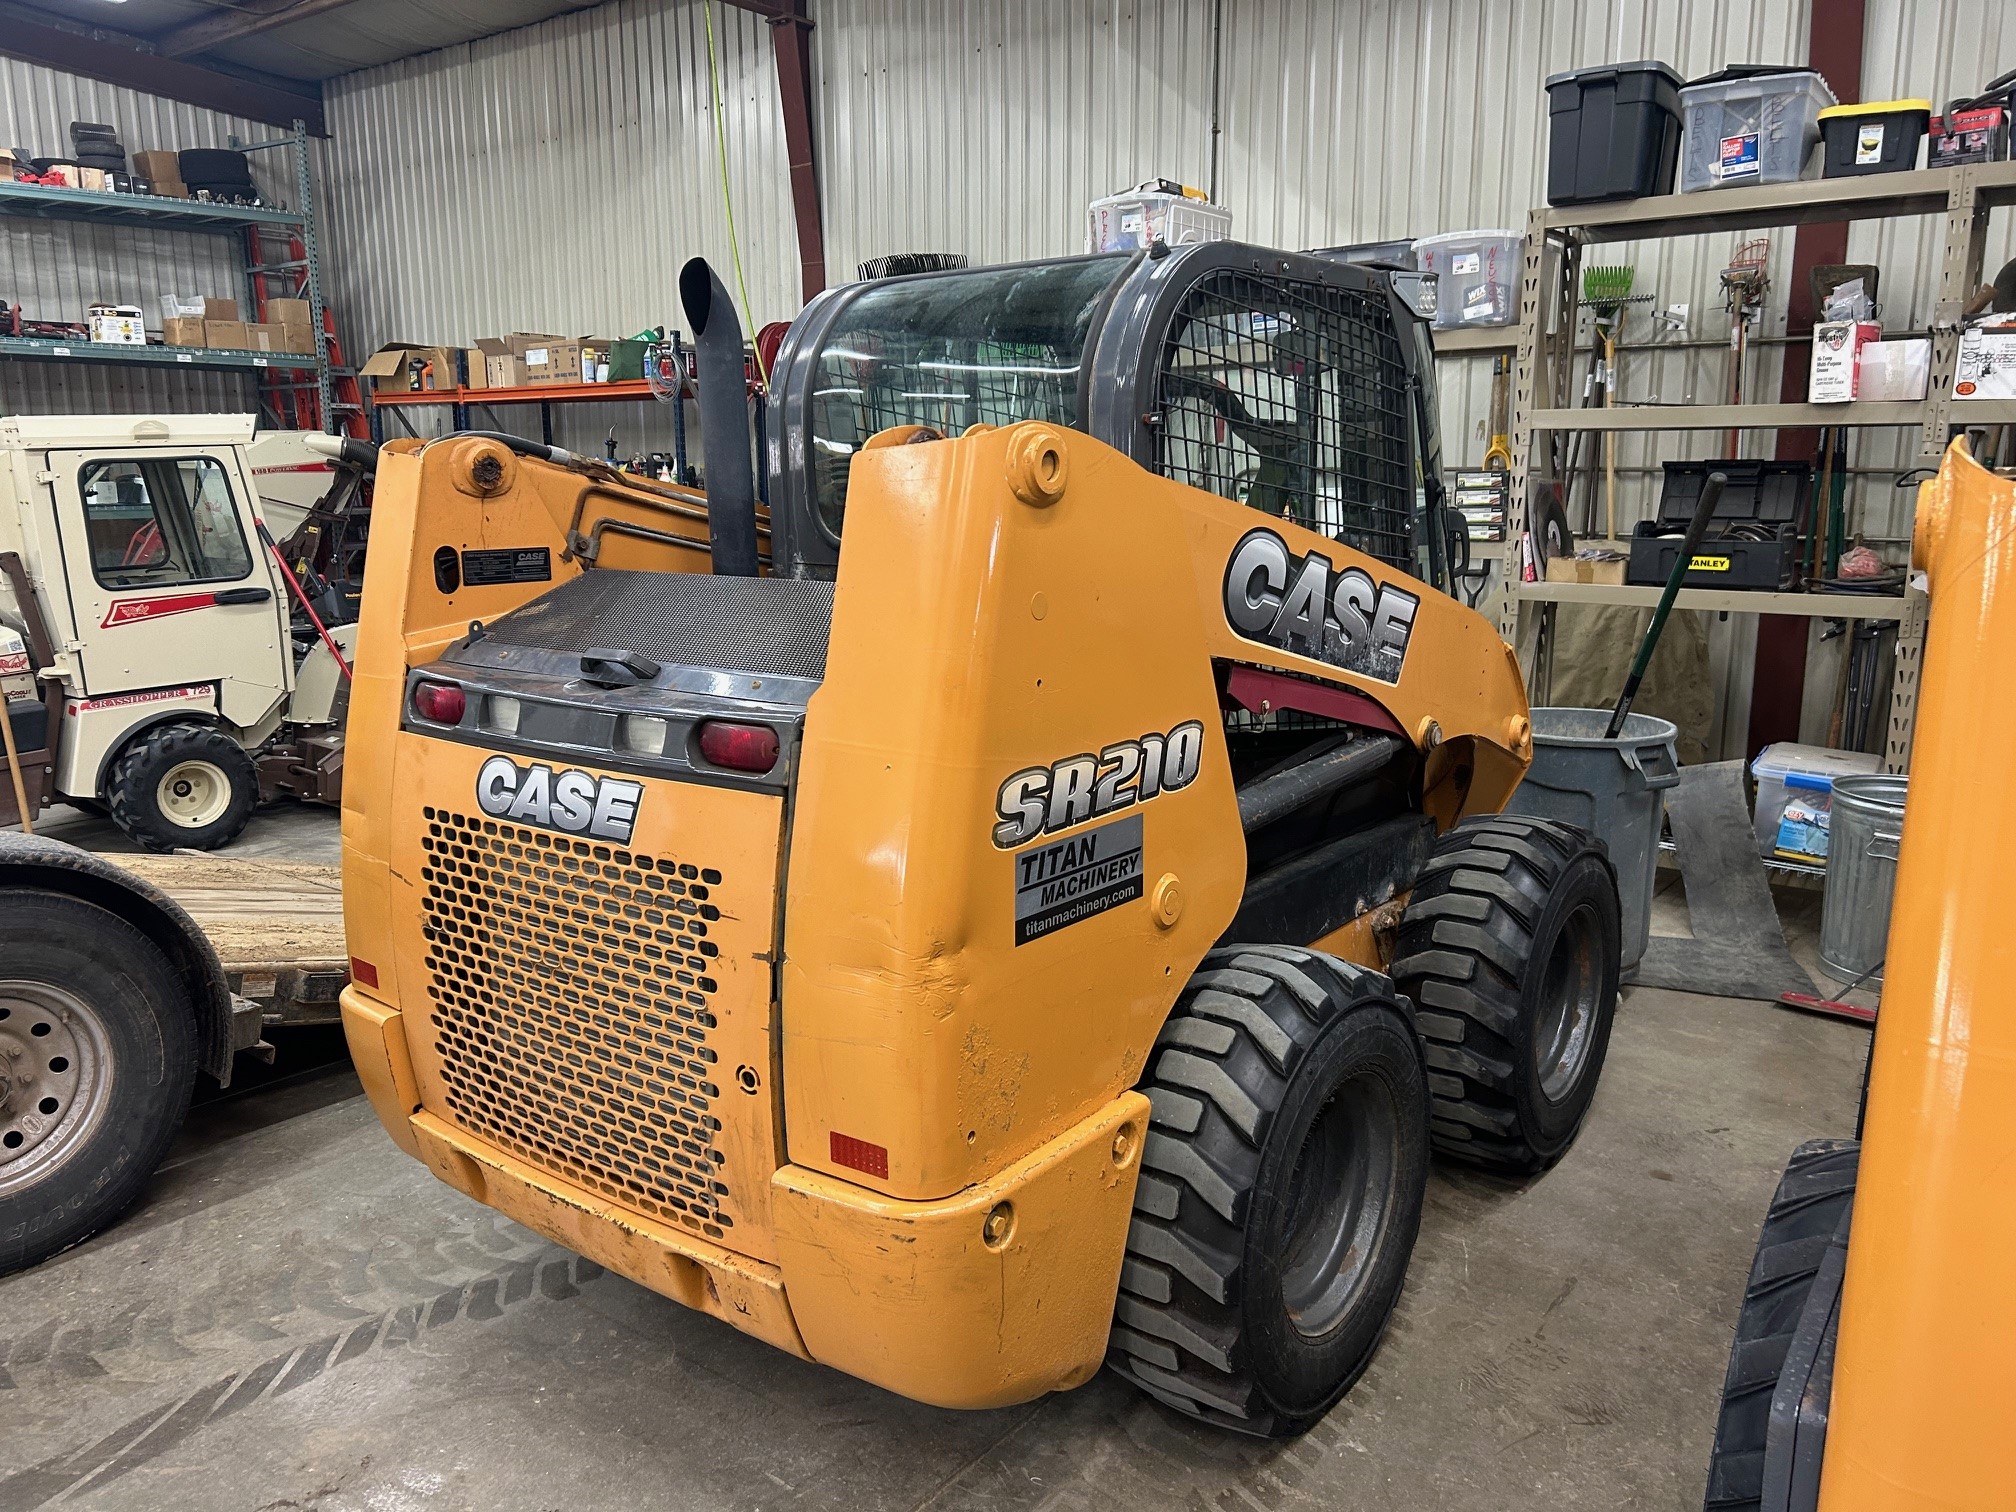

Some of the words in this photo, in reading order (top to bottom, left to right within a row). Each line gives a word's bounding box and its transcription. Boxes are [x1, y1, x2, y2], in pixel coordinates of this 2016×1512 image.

[1468, 284, 1487, 301] WIX
[1496, 286, 1505, 313] WIX
[518, 552, 545, 561] CASE
[1690, 559, 1726, 568] TANLEY
[1224, 527, 1420, 684] CASE
[88, 689, 182, 709] GRASSHOPPER
[478, 755, 643, 844] CASE
[992, 719, 1204, 851] SR210
[1020, 833, 1098, 886] TITAN
[1040, 853, 1140, 907] MACHINERY
[1025, 884, 1135, 937] titanmachinery.com
